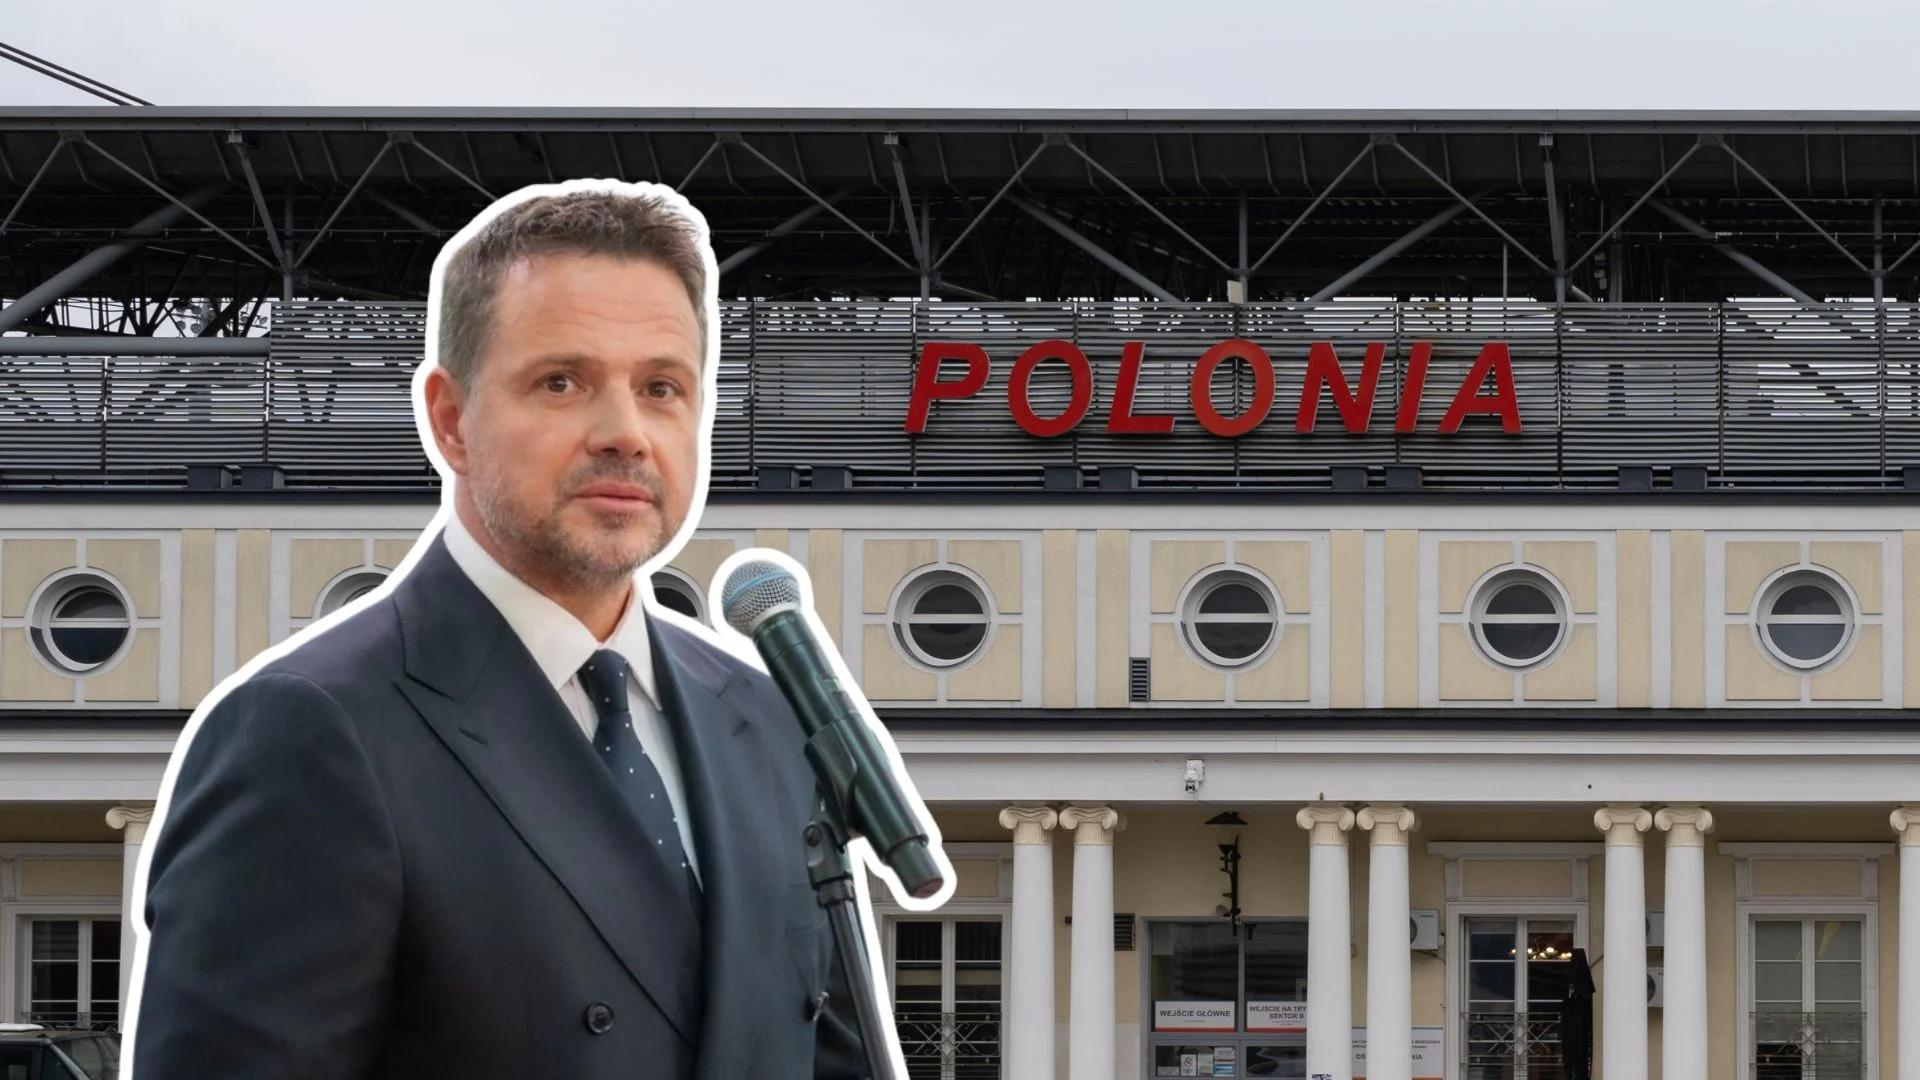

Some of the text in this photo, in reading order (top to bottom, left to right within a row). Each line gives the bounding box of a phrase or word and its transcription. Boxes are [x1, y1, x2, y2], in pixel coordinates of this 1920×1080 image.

[904, 339, 1523, 437] POLONIA
[1160, 1009, 1231, 1017] WEJŚCIE GŁÓWNE
